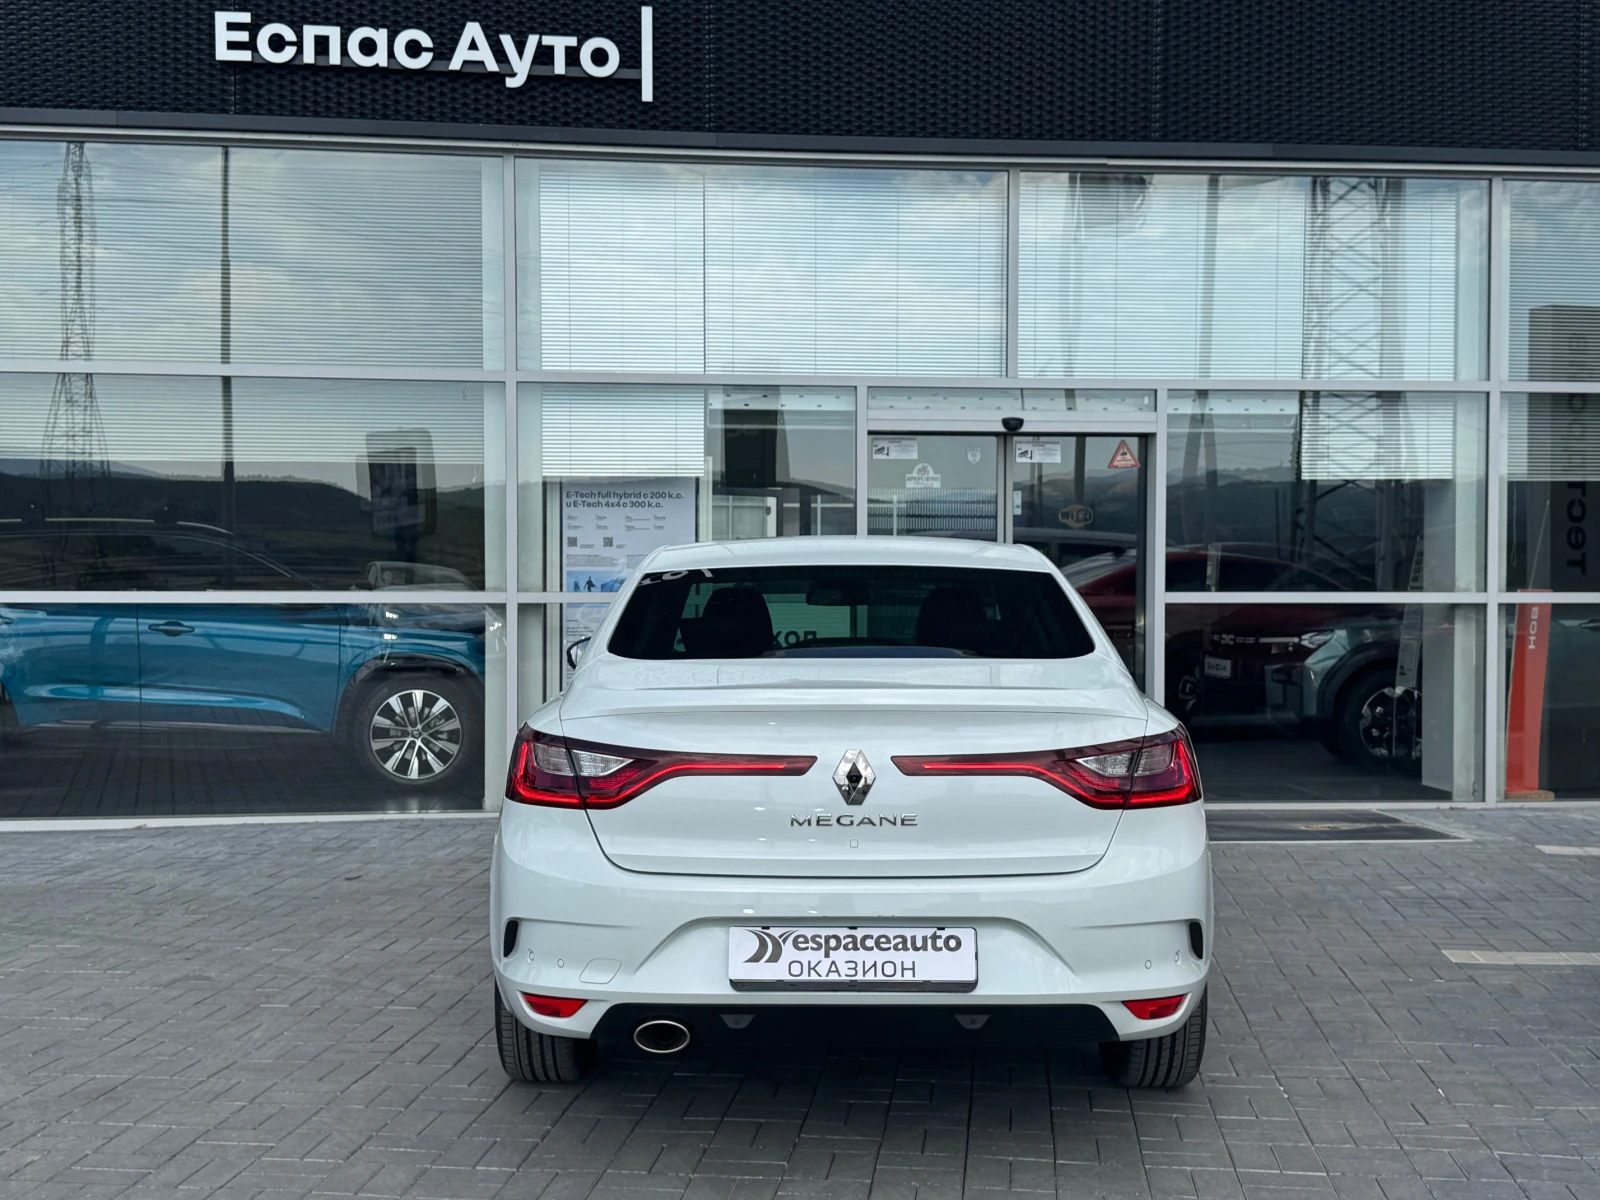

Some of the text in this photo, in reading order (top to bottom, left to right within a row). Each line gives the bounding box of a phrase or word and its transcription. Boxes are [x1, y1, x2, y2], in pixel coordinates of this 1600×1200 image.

[214, 11, 620, 88] Еспас Ауто
[566, 491, 596, 499] E-Tech
[597, 491, 611, 499] full
[612, 491, 642, 500] hybrid
[573, 500, 603, 508] E-Tech
[1528, 607, 1539, 649] НОВ
[790, 813, 918, 827] MEGANE
[791, 930, 962, 958] espaceauto
[788, 960, 916, 978] ОКАЗИОН
